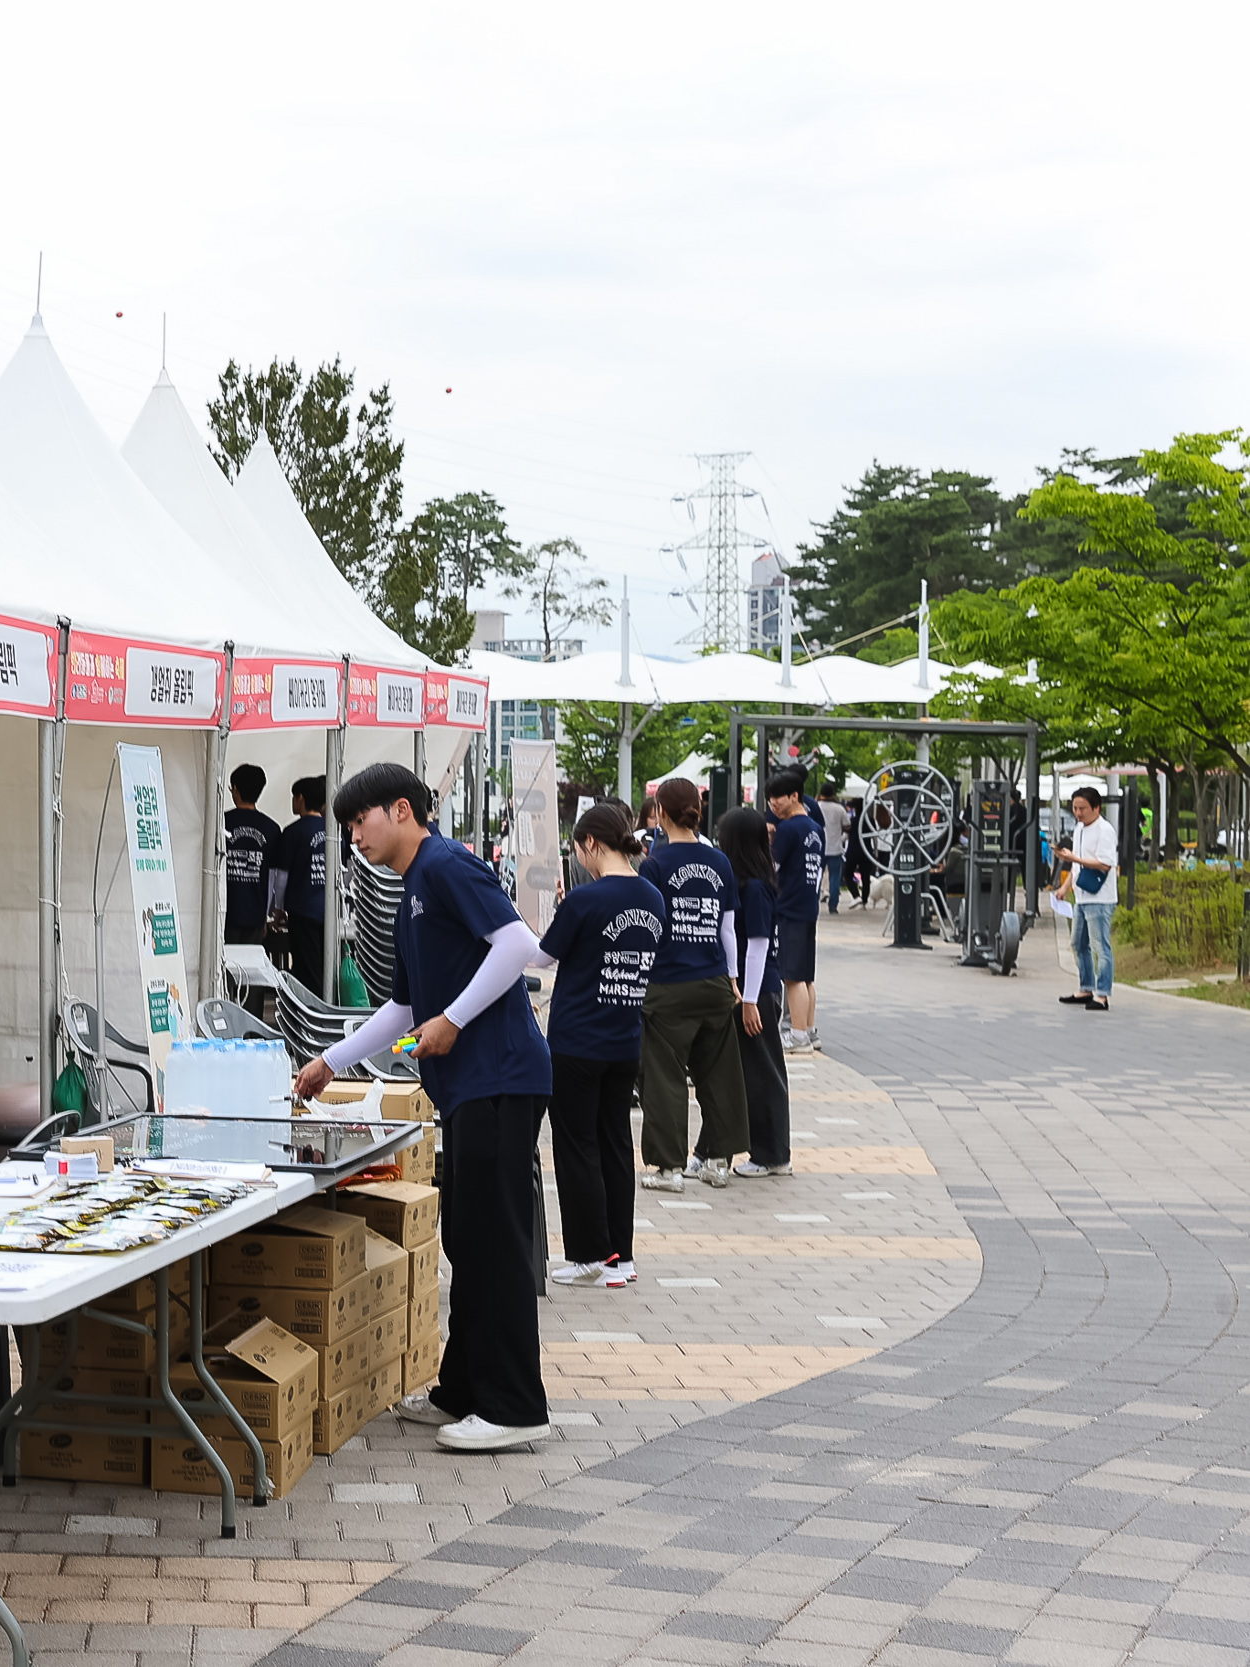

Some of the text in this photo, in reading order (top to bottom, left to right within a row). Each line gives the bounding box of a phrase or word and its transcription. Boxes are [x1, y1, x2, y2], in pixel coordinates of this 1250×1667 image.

[150, 665, 172, 704] 갱얼쥐
[173, 668, 195, 706] 올림픽
[137, 818, 163, 851] 올림픽
[668, 863, 724, 893] KONKUK
[671, 923, 693, 935] MARS
[599, 981, 629, 997] MARS
